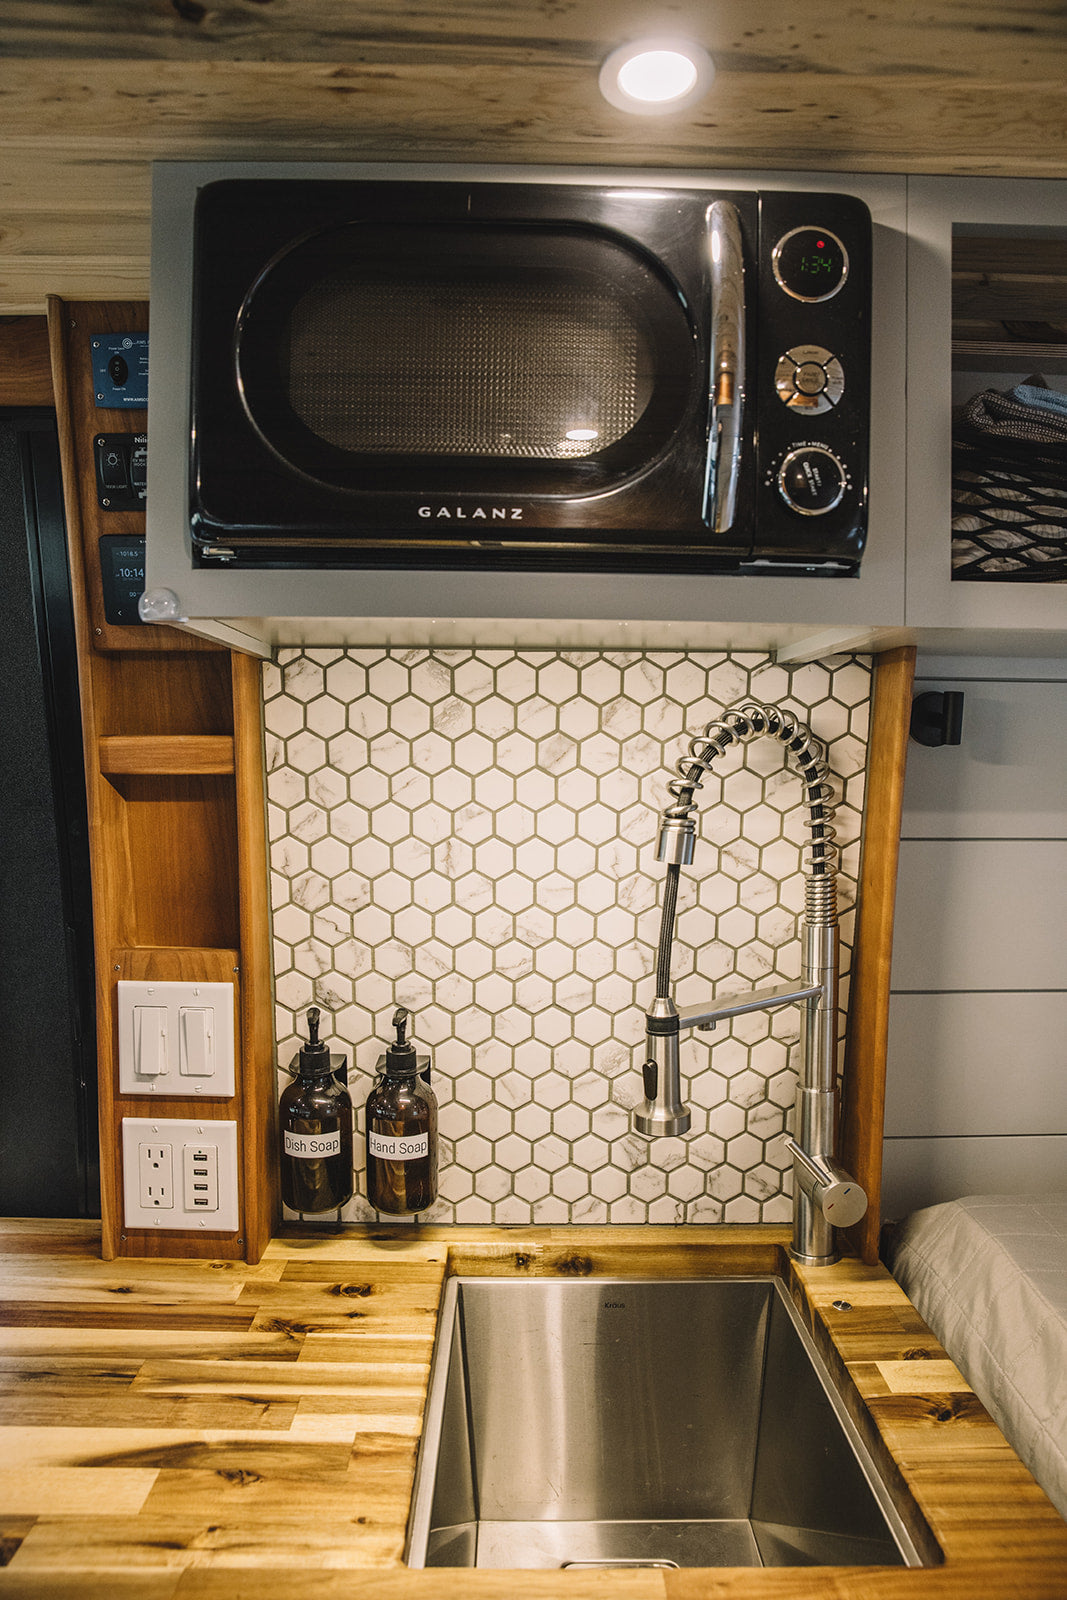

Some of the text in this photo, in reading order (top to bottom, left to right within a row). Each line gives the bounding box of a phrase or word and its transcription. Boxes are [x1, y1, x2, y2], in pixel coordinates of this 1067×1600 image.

[801, 256, 832, 274] 1:34
[811, 441, 830, 450] MENU
[808, 479, 818, 496] START
[417, 506, 523, 520] GALANZ
[119, 568, 145, 578] 10:14
[285, 1136, 339, 1153] Dish Soap
[370, 1139, 427, 1155] Hand Soap
